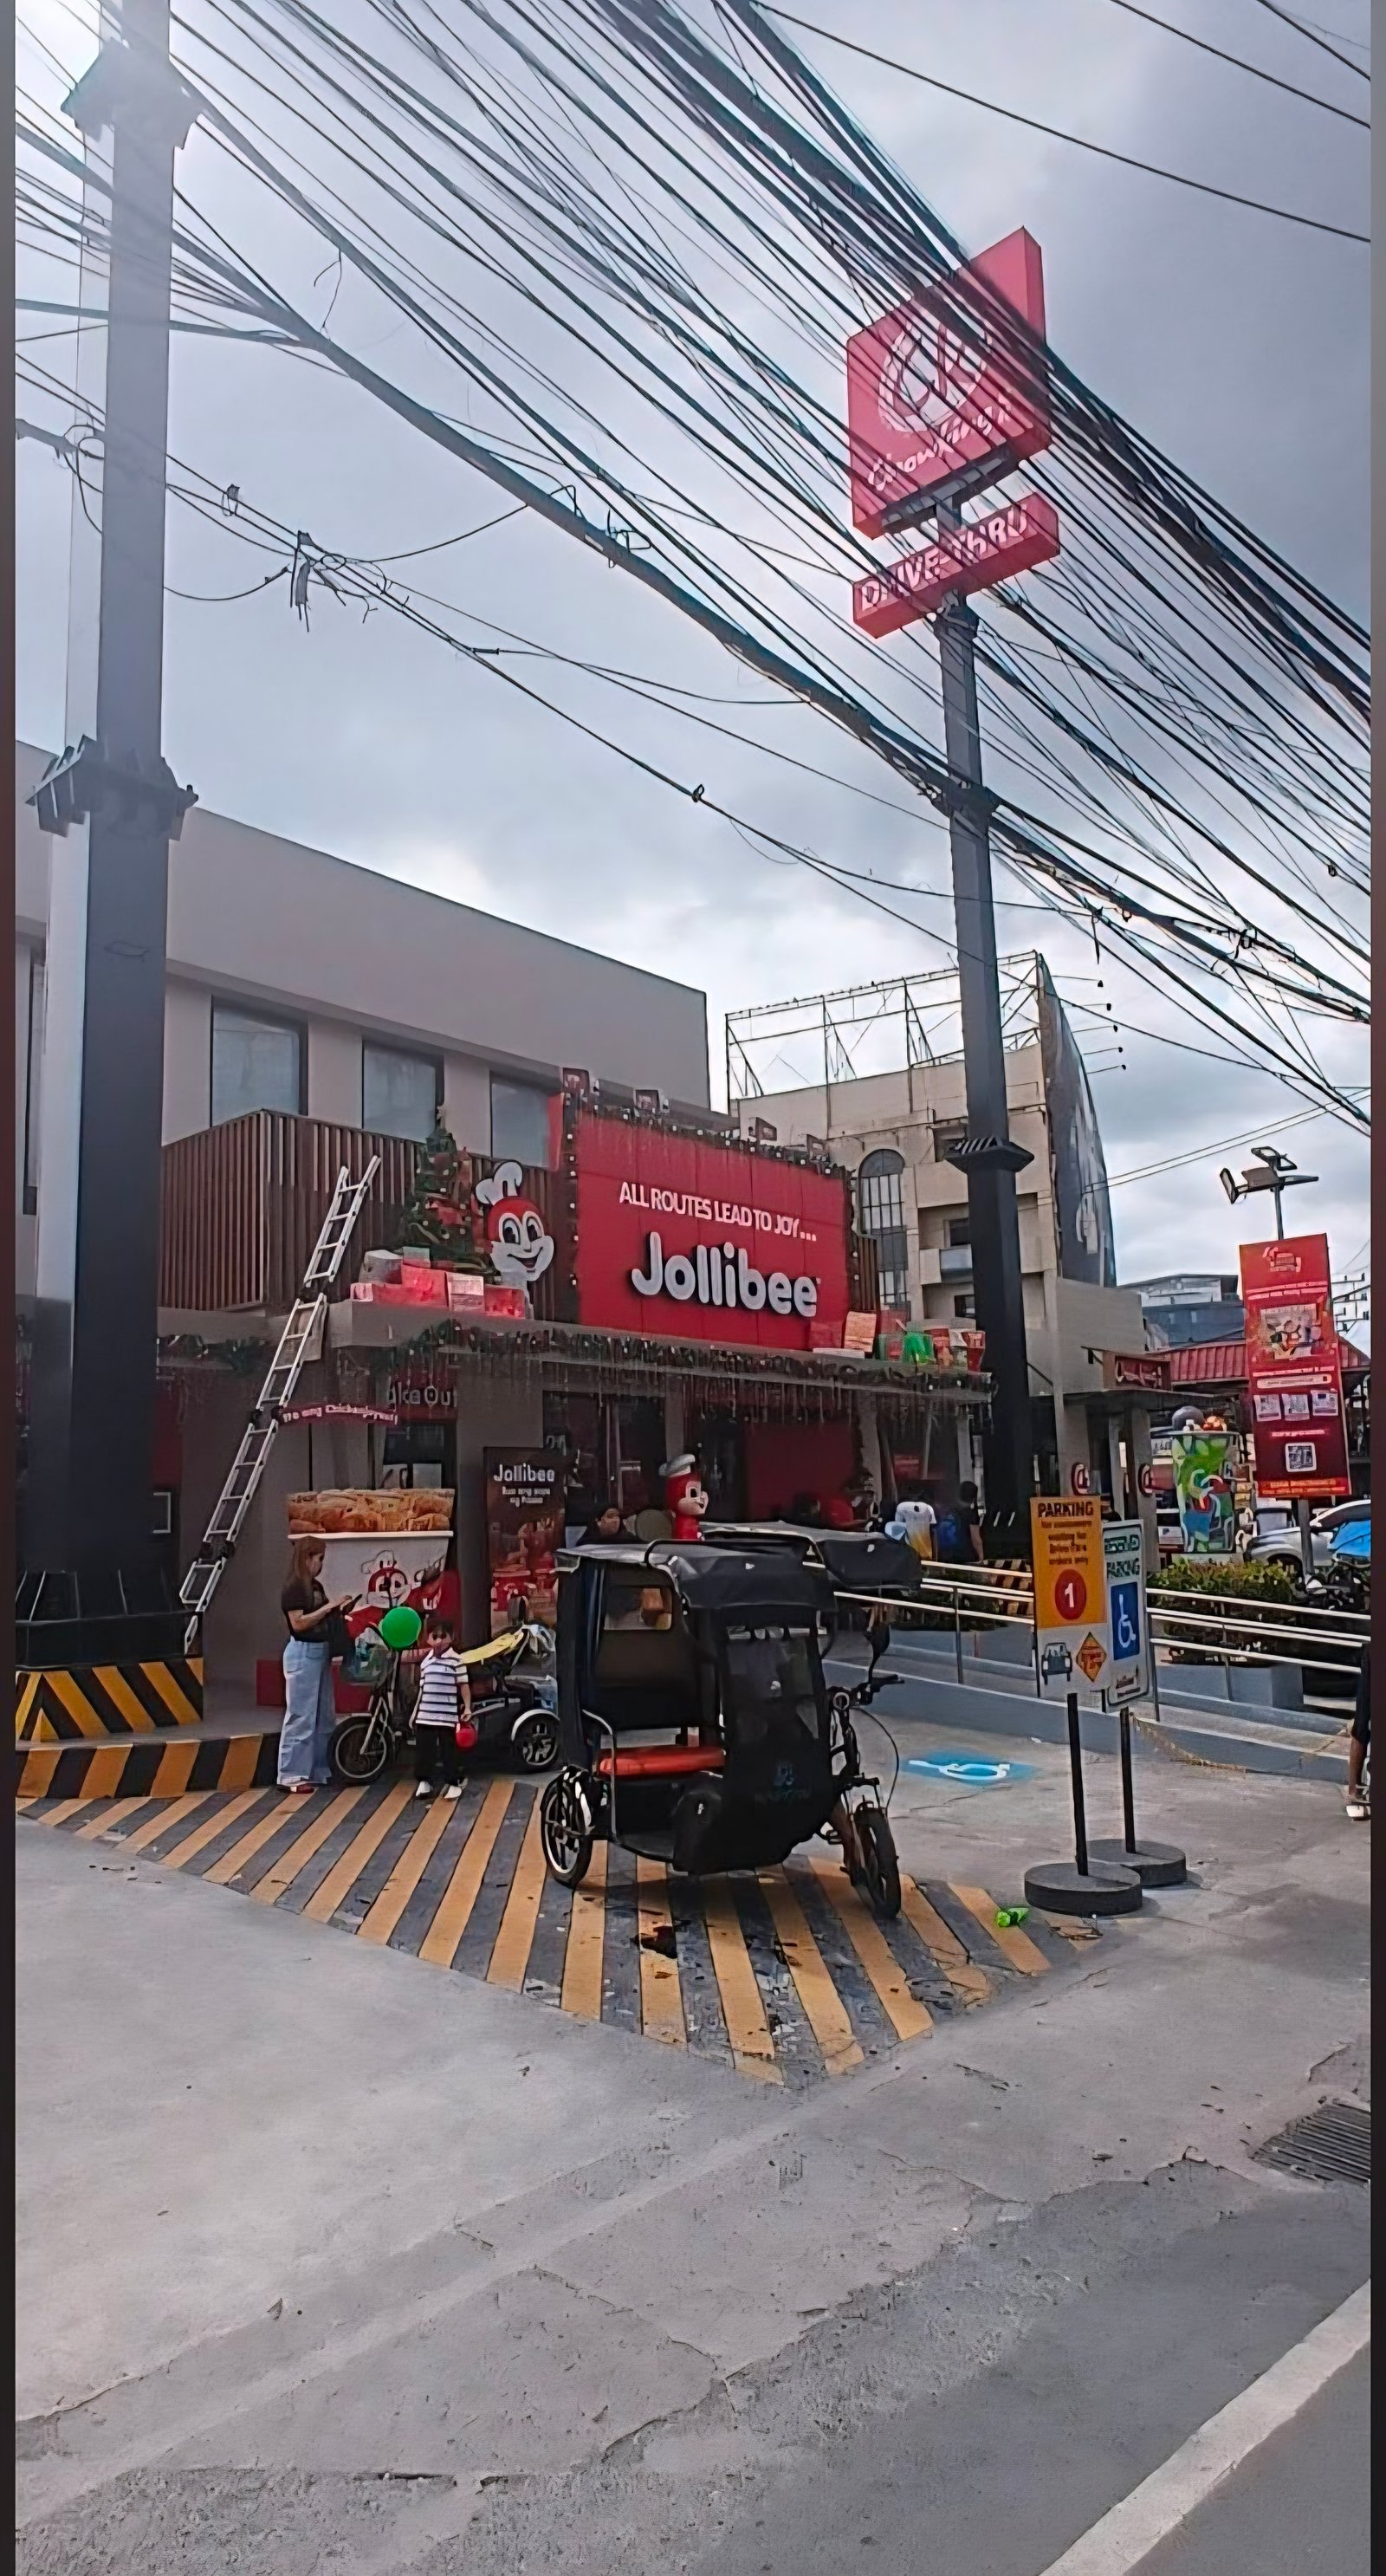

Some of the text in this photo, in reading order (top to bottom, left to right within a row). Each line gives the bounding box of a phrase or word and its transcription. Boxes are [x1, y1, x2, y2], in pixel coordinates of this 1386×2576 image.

[619, 1181, 650, 1208] ALL
[651, 1187, 713, 1221] ROUTES
[714, 1200, 752, 1227] LEAD
[752, 1209, 772, 1231] TO
[631, 1230, 818, 1318] Jollibee
[493, 1463, 555, 1483] Jollibee
[1037, 1500, 1094, 1518] PARKING
[1064, 1582, 1075, 1608] 1
